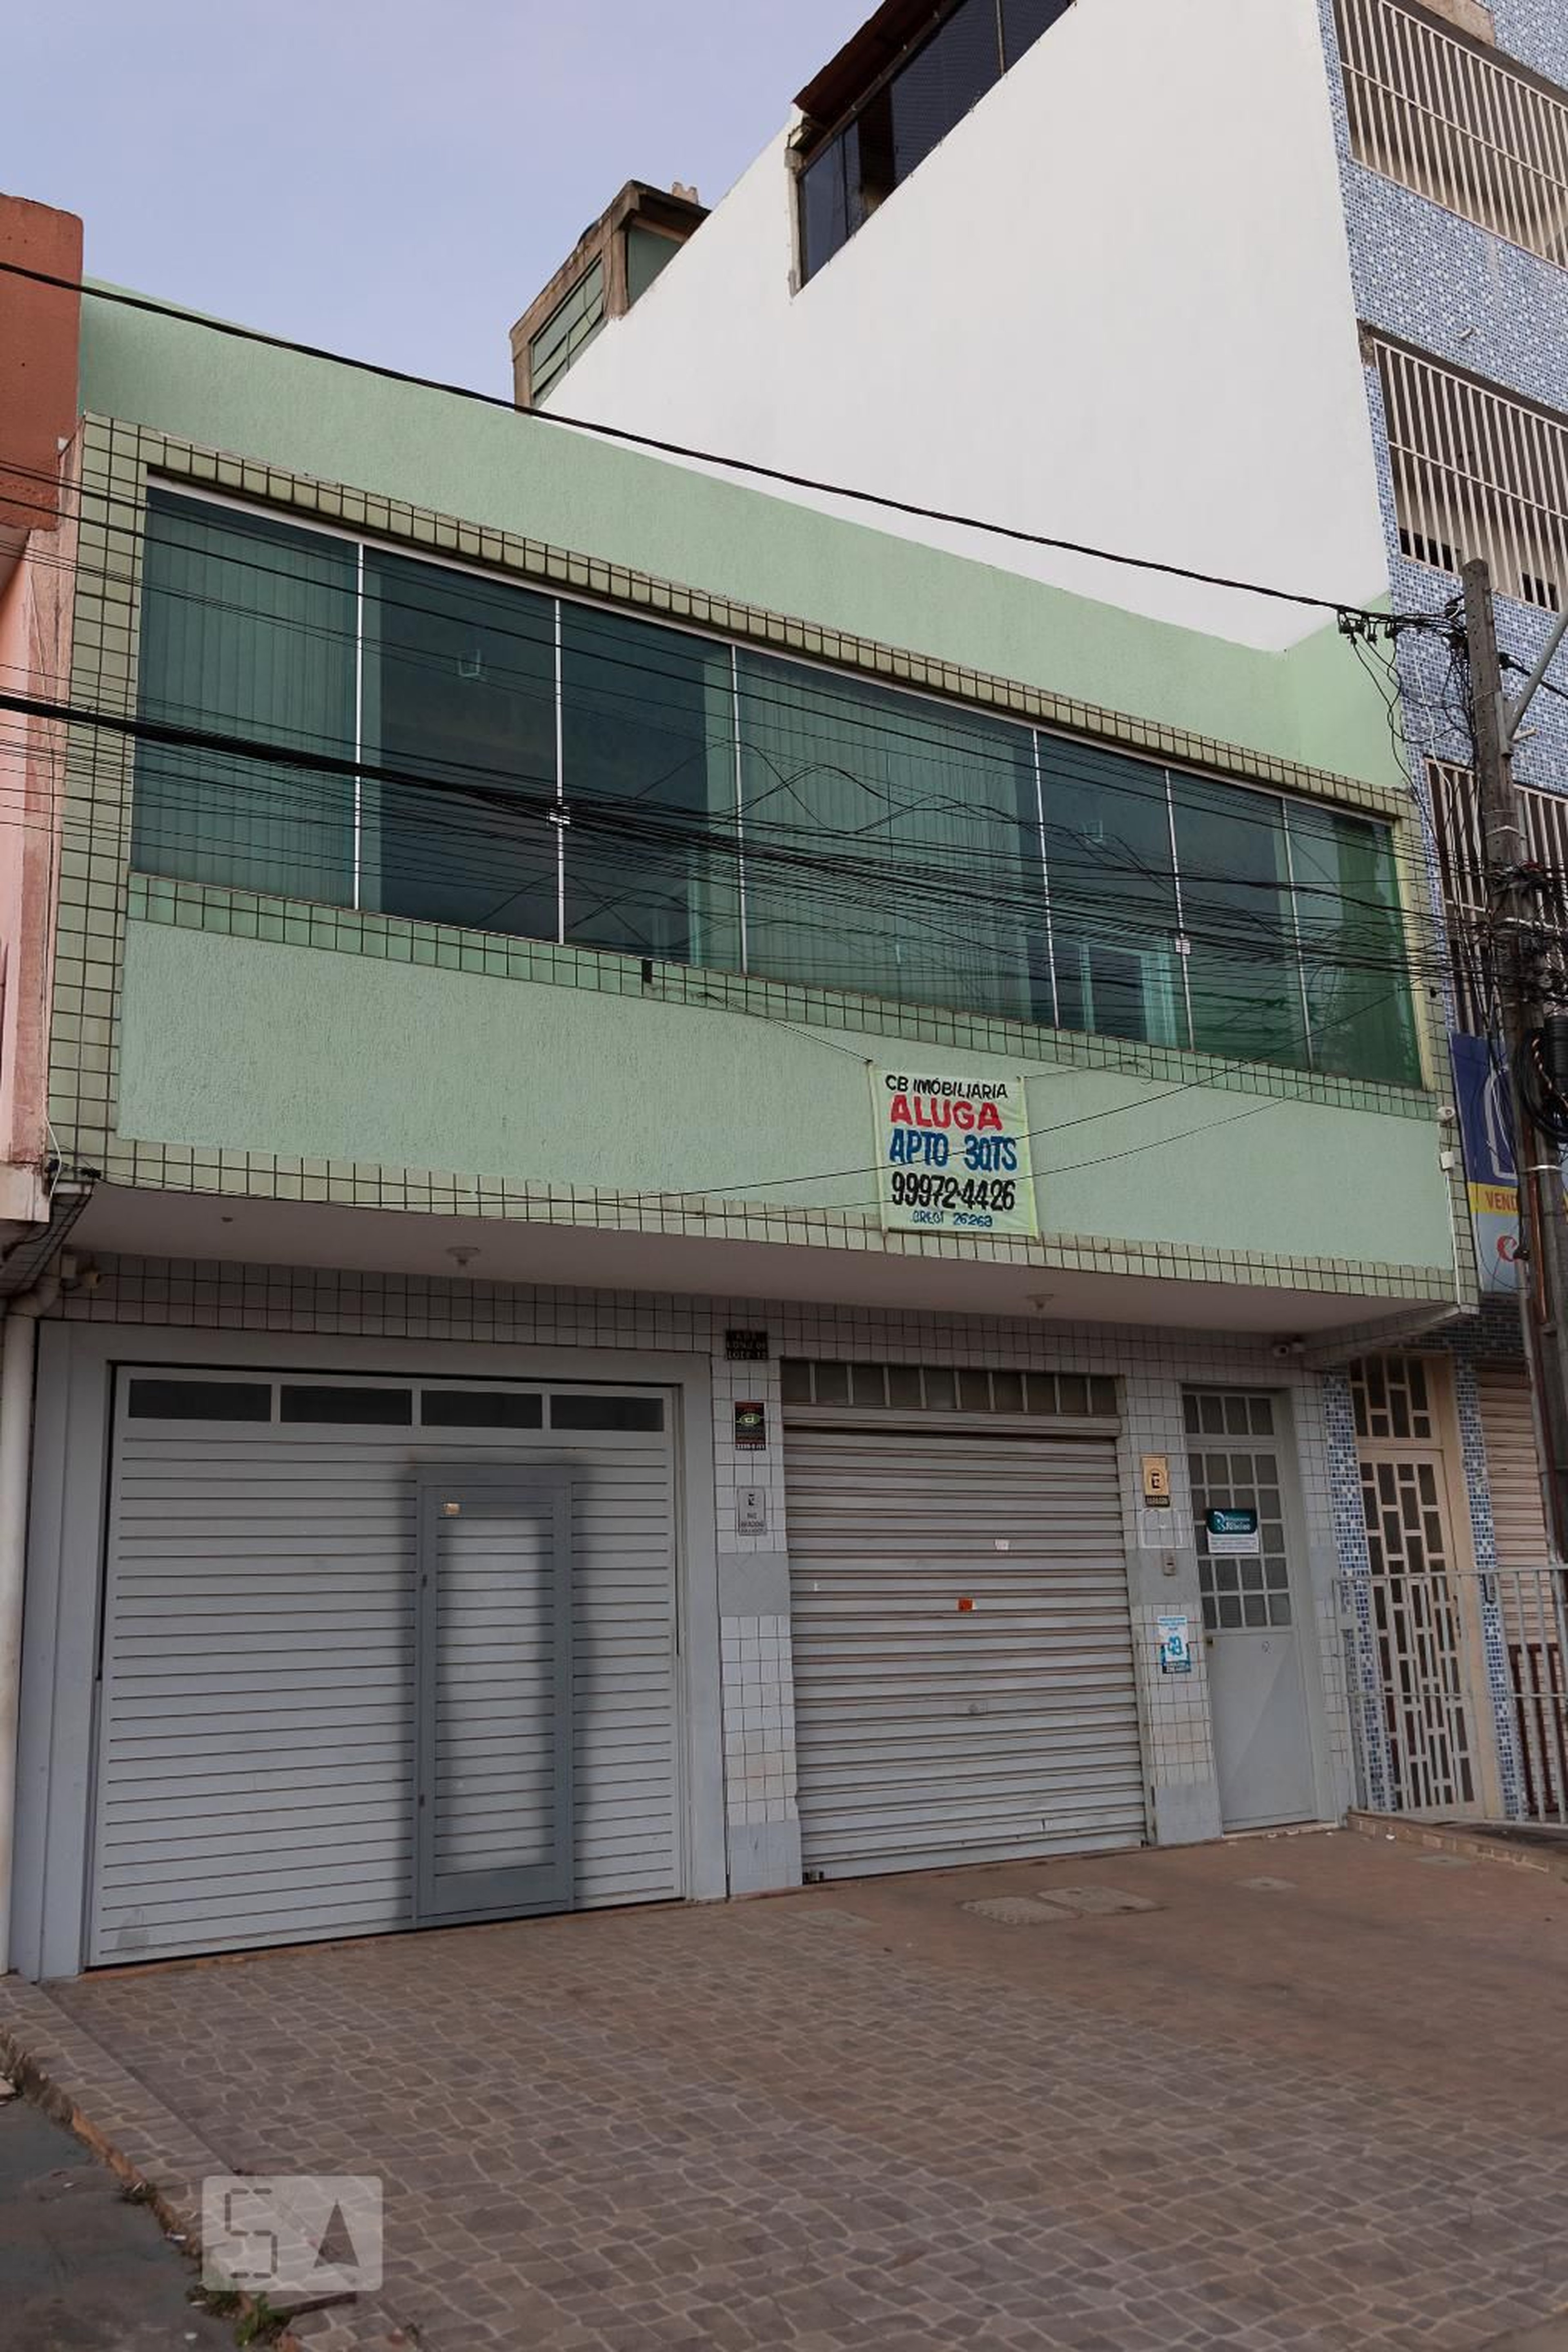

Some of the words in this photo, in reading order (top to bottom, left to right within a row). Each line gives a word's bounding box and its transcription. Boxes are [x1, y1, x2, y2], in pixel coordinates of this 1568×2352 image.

[885, 1074, 909, 1092] CB
[890, 1094, 1003, 1131] ALUGA
[889, 1128, 949, 1167] APTO
[1485, 1191, 1518, 1212] VEND
